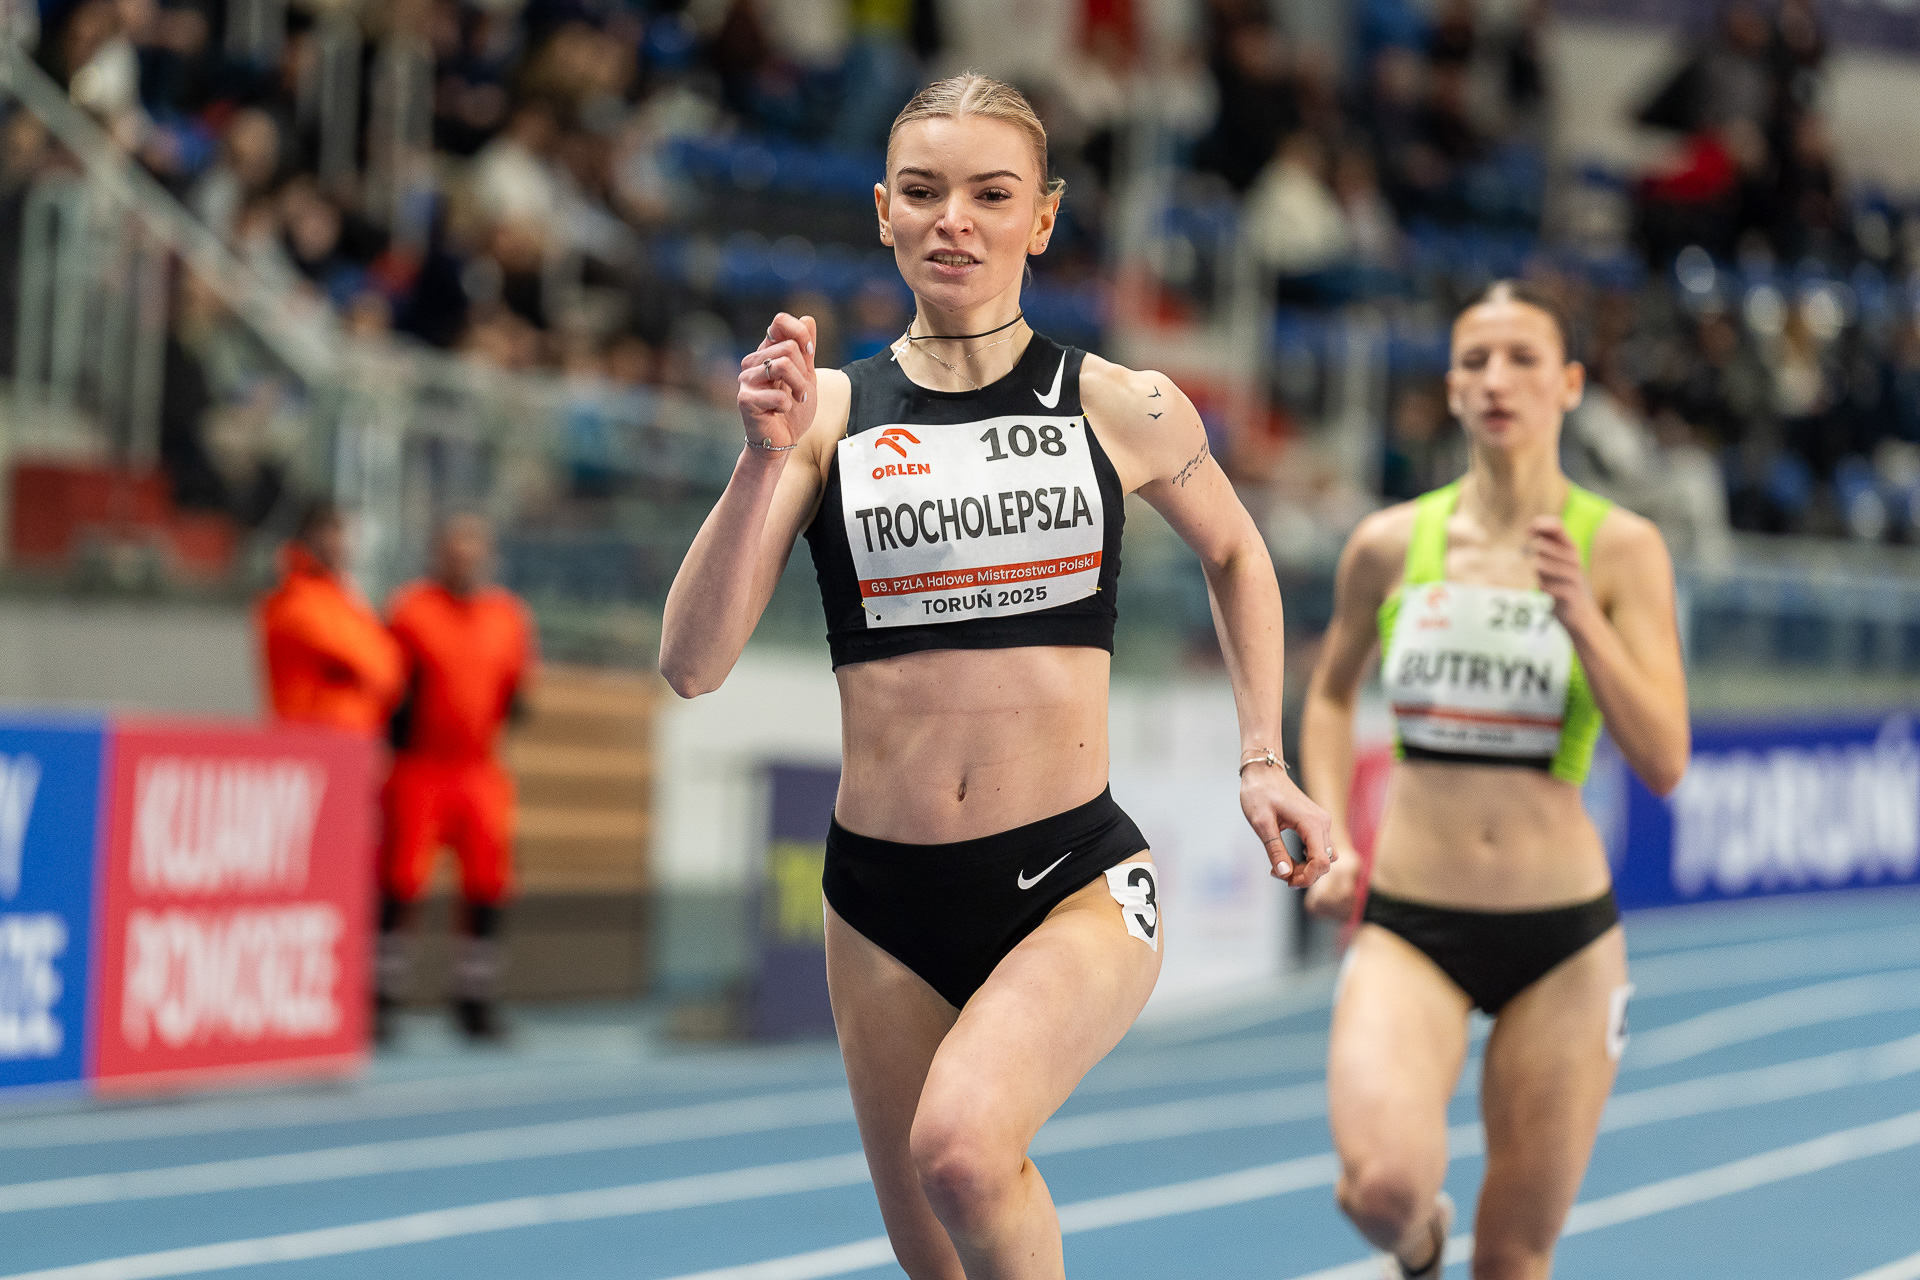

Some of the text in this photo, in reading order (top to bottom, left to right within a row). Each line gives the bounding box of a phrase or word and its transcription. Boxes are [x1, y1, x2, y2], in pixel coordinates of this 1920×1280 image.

[979, 424, 1067, 462] 108
[872, 463, 931, 480] ORLEN
[856, 486, 1093, 552] TROCHOLEPSZA
[871, 556, 1094, 593] 69. PZLA Halowe Mistrzostwa Polski
[922, 586, 1047, 614] TORUŃ 2025
[1400, 650, 1553, 695] BUTRYN
[1128, 868, 1157, 938] 3
